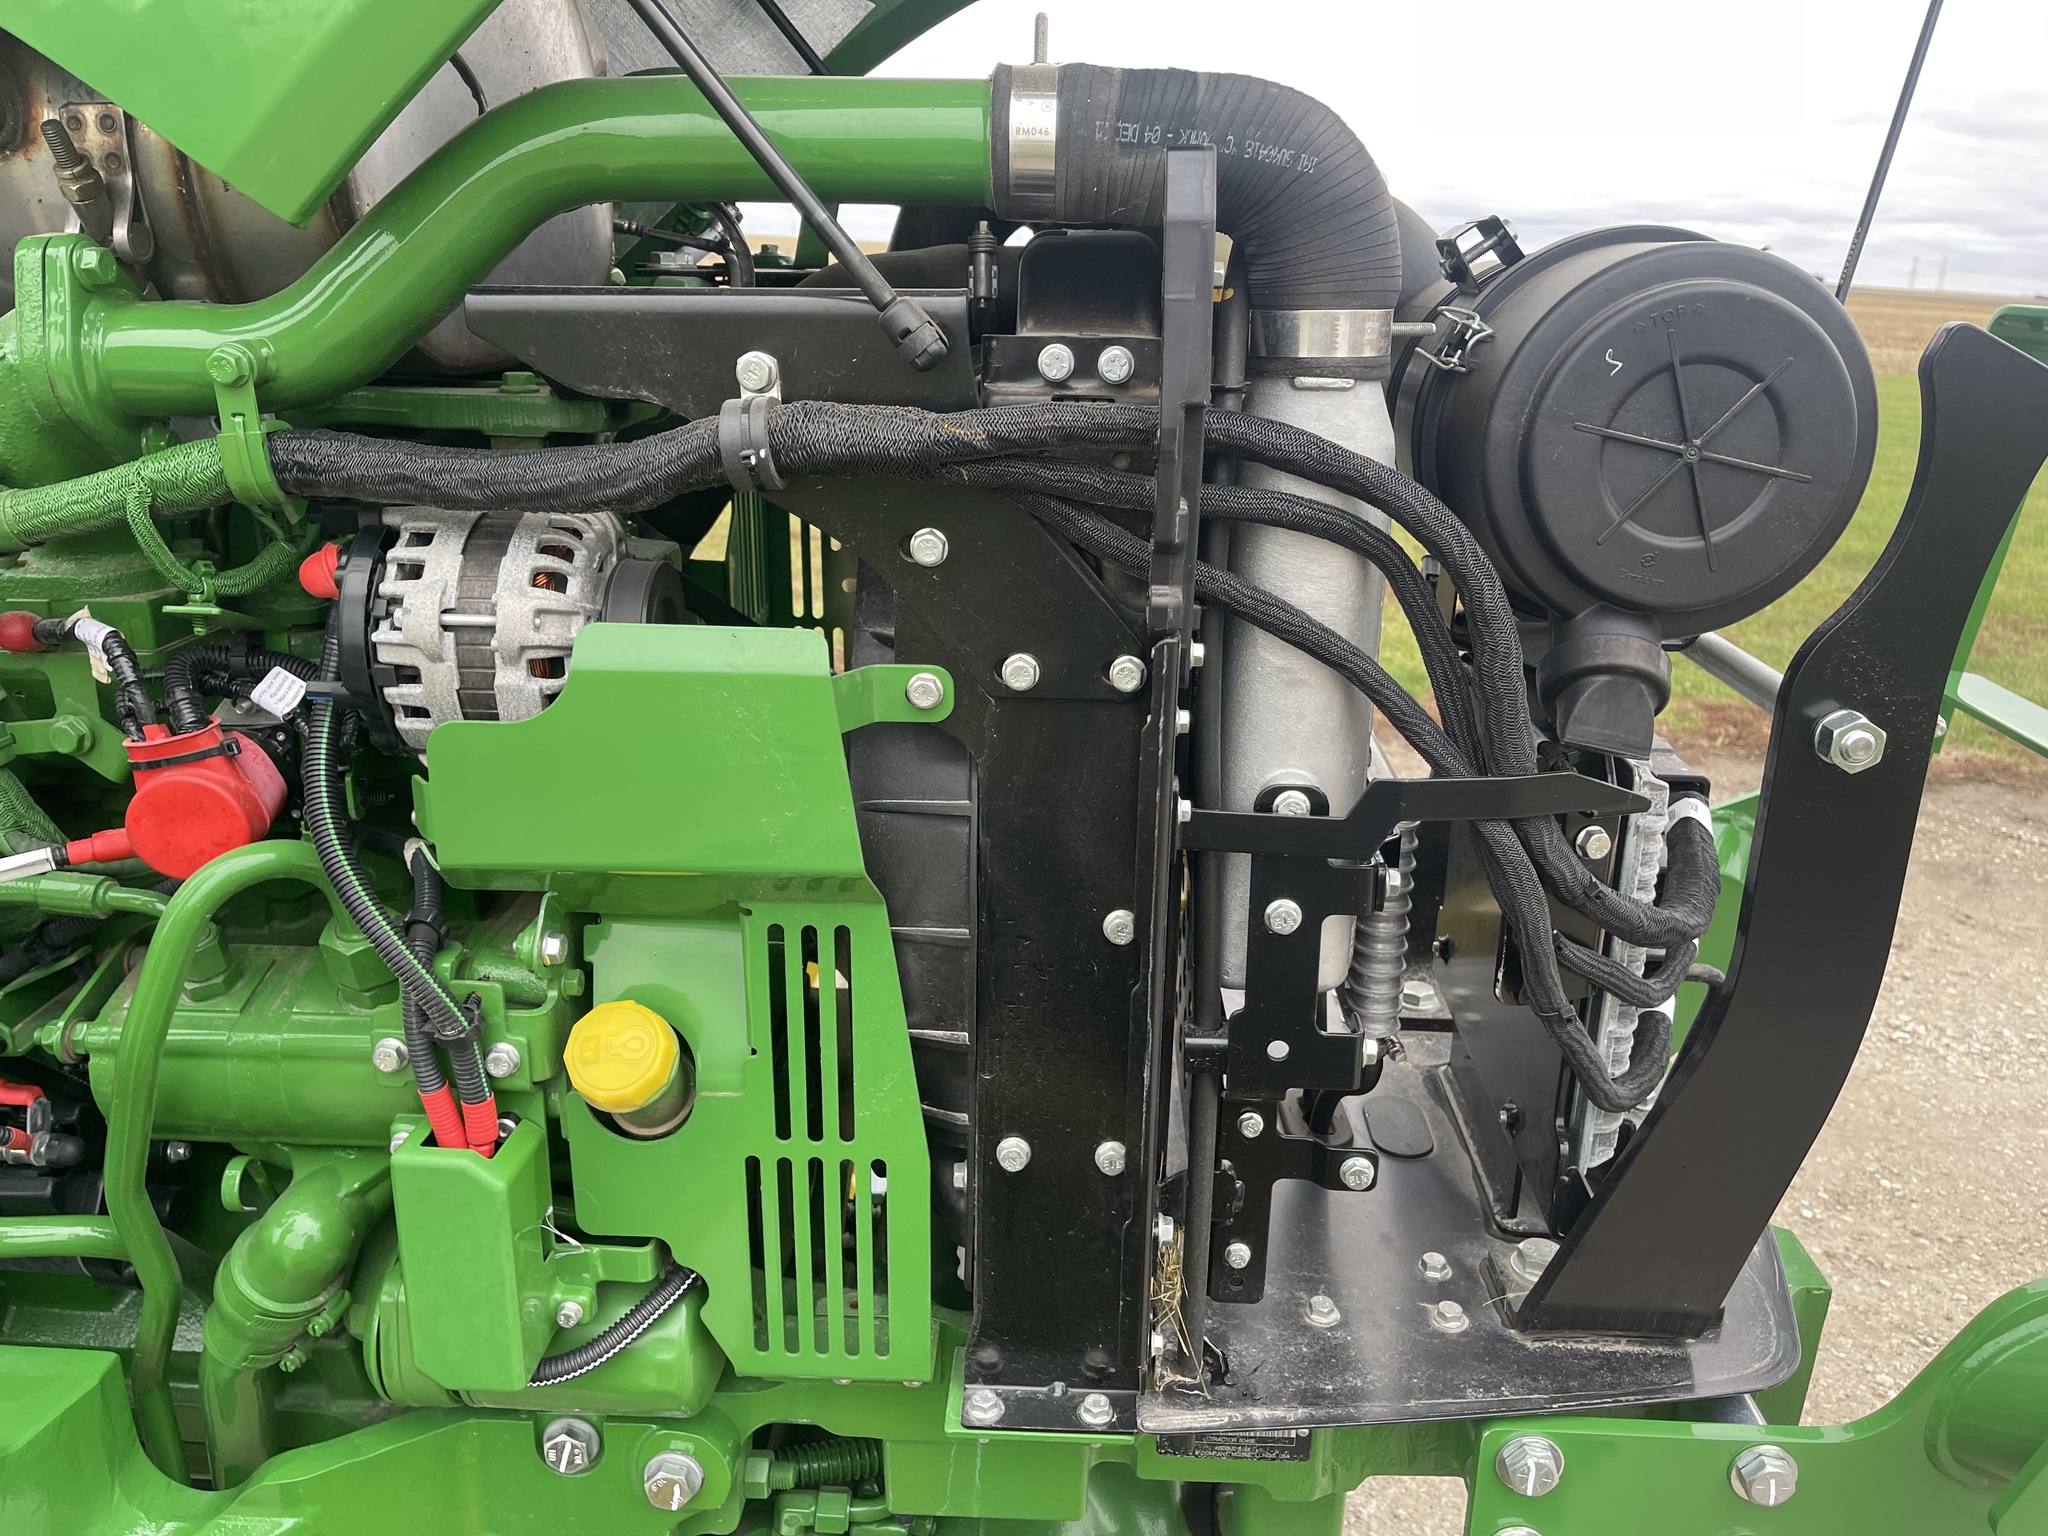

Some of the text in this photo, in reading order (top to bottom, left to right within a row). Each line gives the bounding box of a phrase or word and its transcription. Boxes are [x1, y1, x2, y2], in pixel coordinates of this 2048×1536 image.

[1015, 126, 1050, 136] RM046
[1144, 121, 1160, 144] 04
[1649, 304, 1686, 326] TOP
